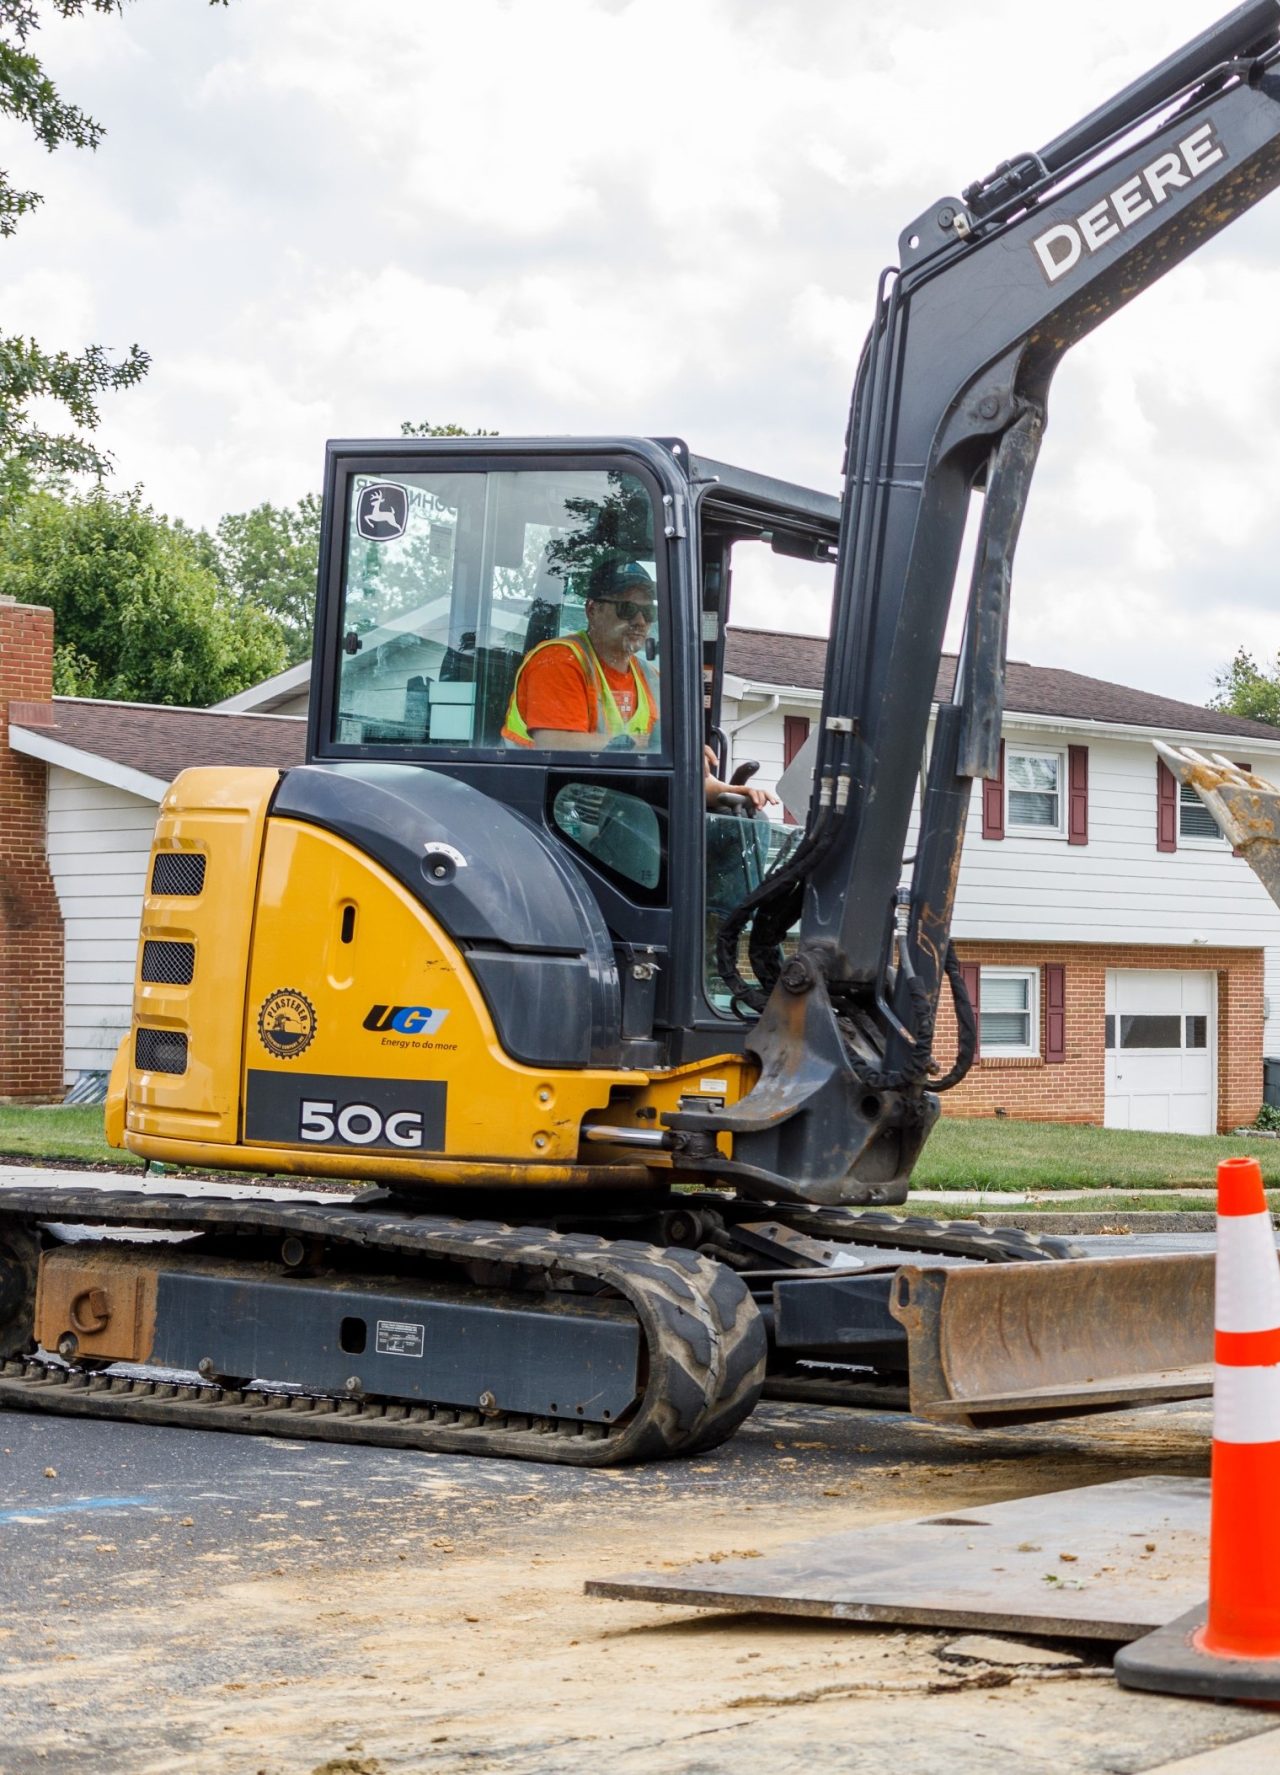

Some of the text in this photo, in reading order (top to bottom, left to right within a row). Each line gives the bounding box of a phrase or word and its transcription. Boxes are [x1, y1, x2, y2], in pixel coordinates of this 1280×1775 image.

[1033, 123, 1223, 281] DEERE
[267, 998, 308, 1022] PLASTERER
[362, 1004, 450, 1035] UGI
[381, 1037, 458, 1051] Energy to do more
[301, 1101, 422, 1147] 50G
